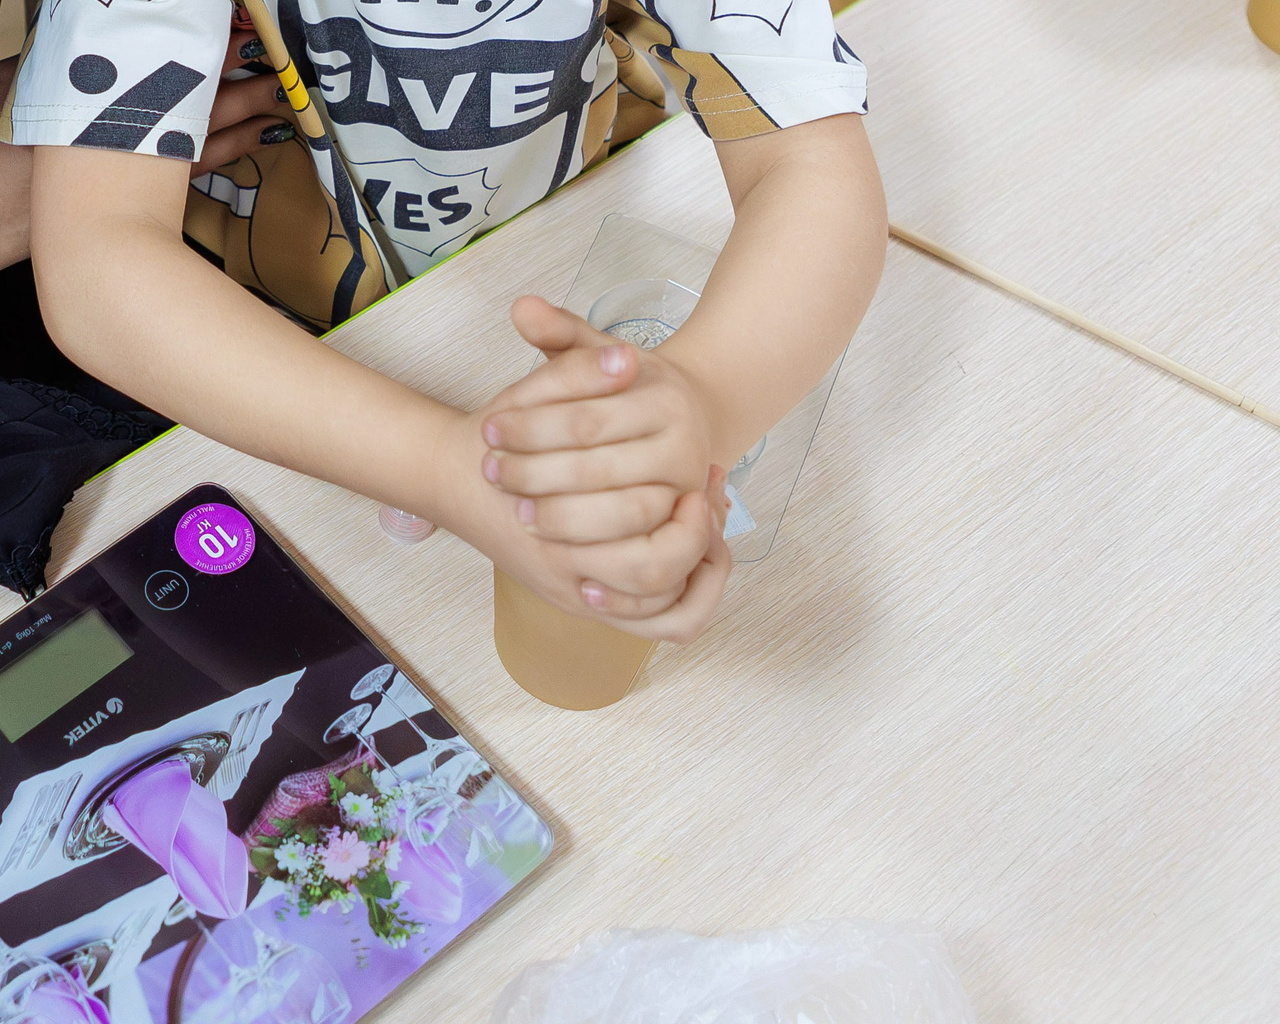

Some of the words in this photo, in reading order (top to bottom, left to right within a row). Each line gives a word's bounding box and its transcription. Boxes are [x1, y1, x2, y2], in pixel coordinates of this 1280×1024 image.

[306, 49, 555, 131] GIVE
[180, 511, 198, 530] FIXING
[197, 505, 216, 515] WALL
[198, 524, 239, 559] 10
[236, 527, 253, 564] НАСТЕННОЕ
[195, 559, 238, 572] КРЕПЛЕНИЕ
[154, 579, 180, 602] UNIT
[15, 626, 36, 641] 10kg
[63, 710, 109, 747] VITEK
